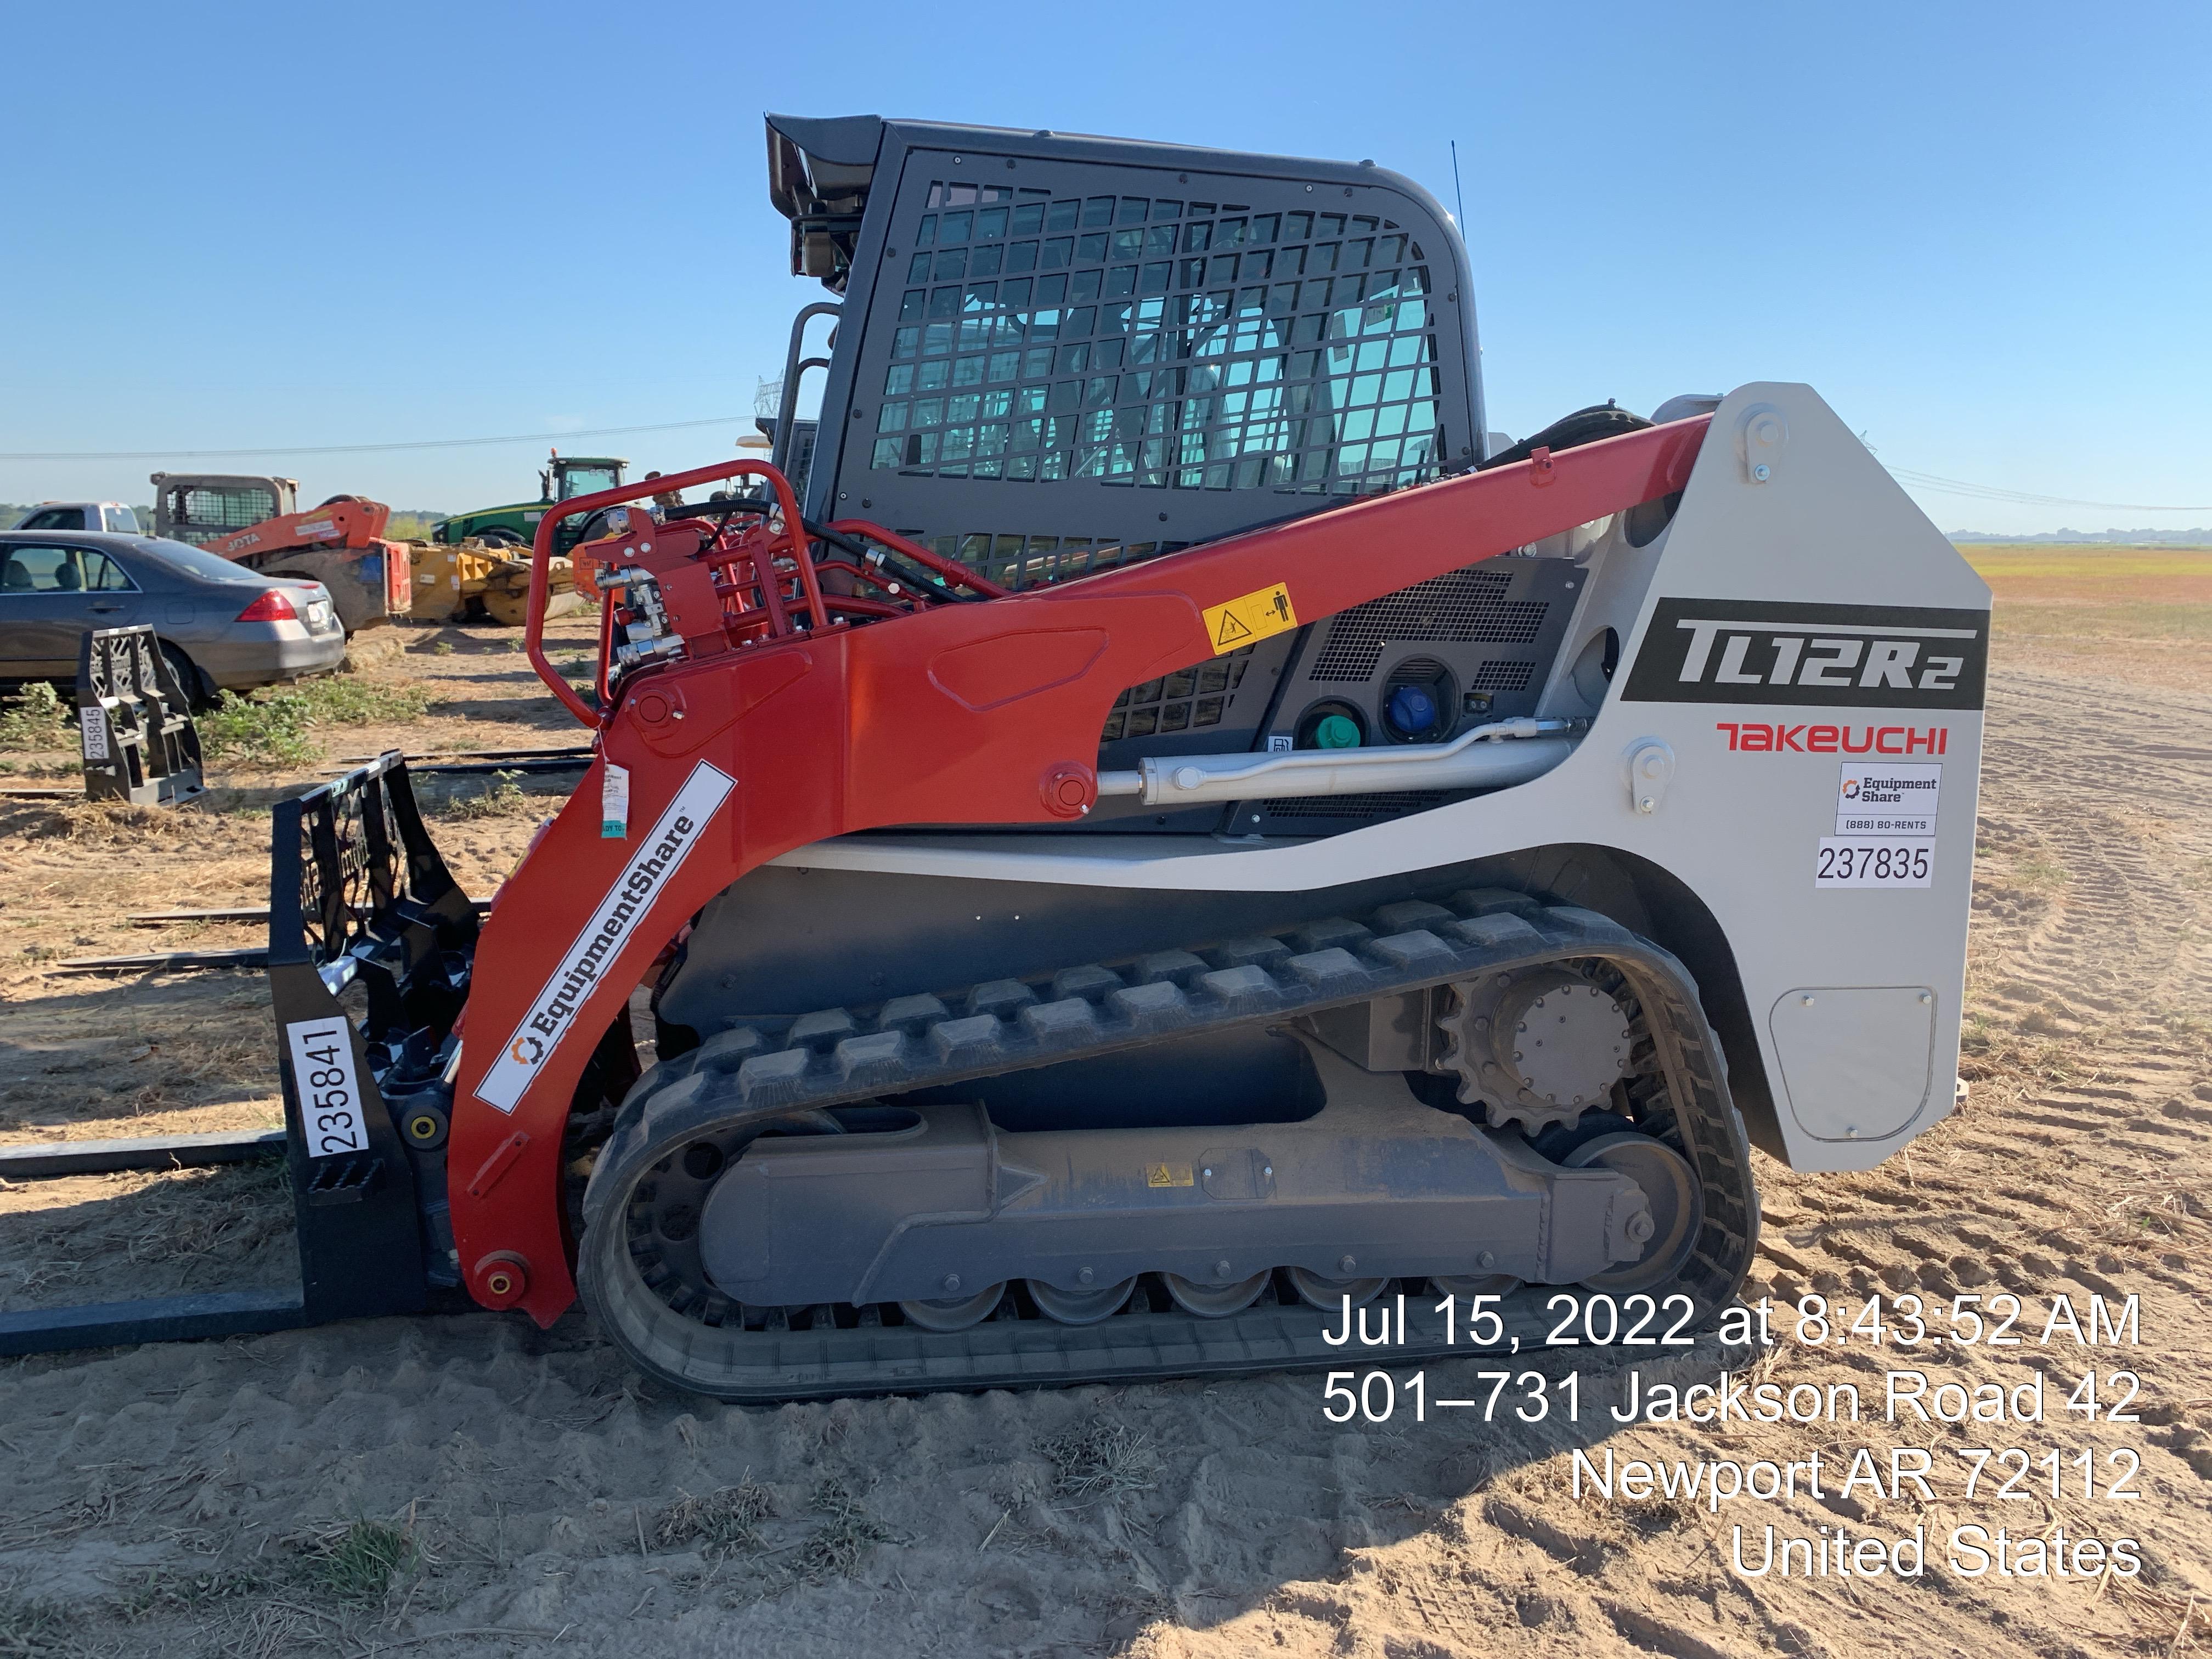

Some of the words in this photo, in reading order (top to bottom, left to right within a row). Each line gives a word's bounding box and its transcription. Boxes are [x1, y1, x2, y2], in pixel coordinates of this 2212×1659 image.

[227, 532, 261, 552] BOTA
[1676, 618, 1978, 690] TL12R2
[85, 708, 104, 759] 235845
[1716, 723, 1948, 755] TAKEUCHI
[1862, 790, 1901, 802] Share
[1863, 777, 1937, 792] Equipment
[1846, 820, 1874, 830] (888)
[1877, 821, 1927, 830] 80-RENTS
[1818, 848, 1929, 879] 237835
[529, 815, 695, 1037] EquipmentShare
[302, 1029, 358, 1154] 235841
